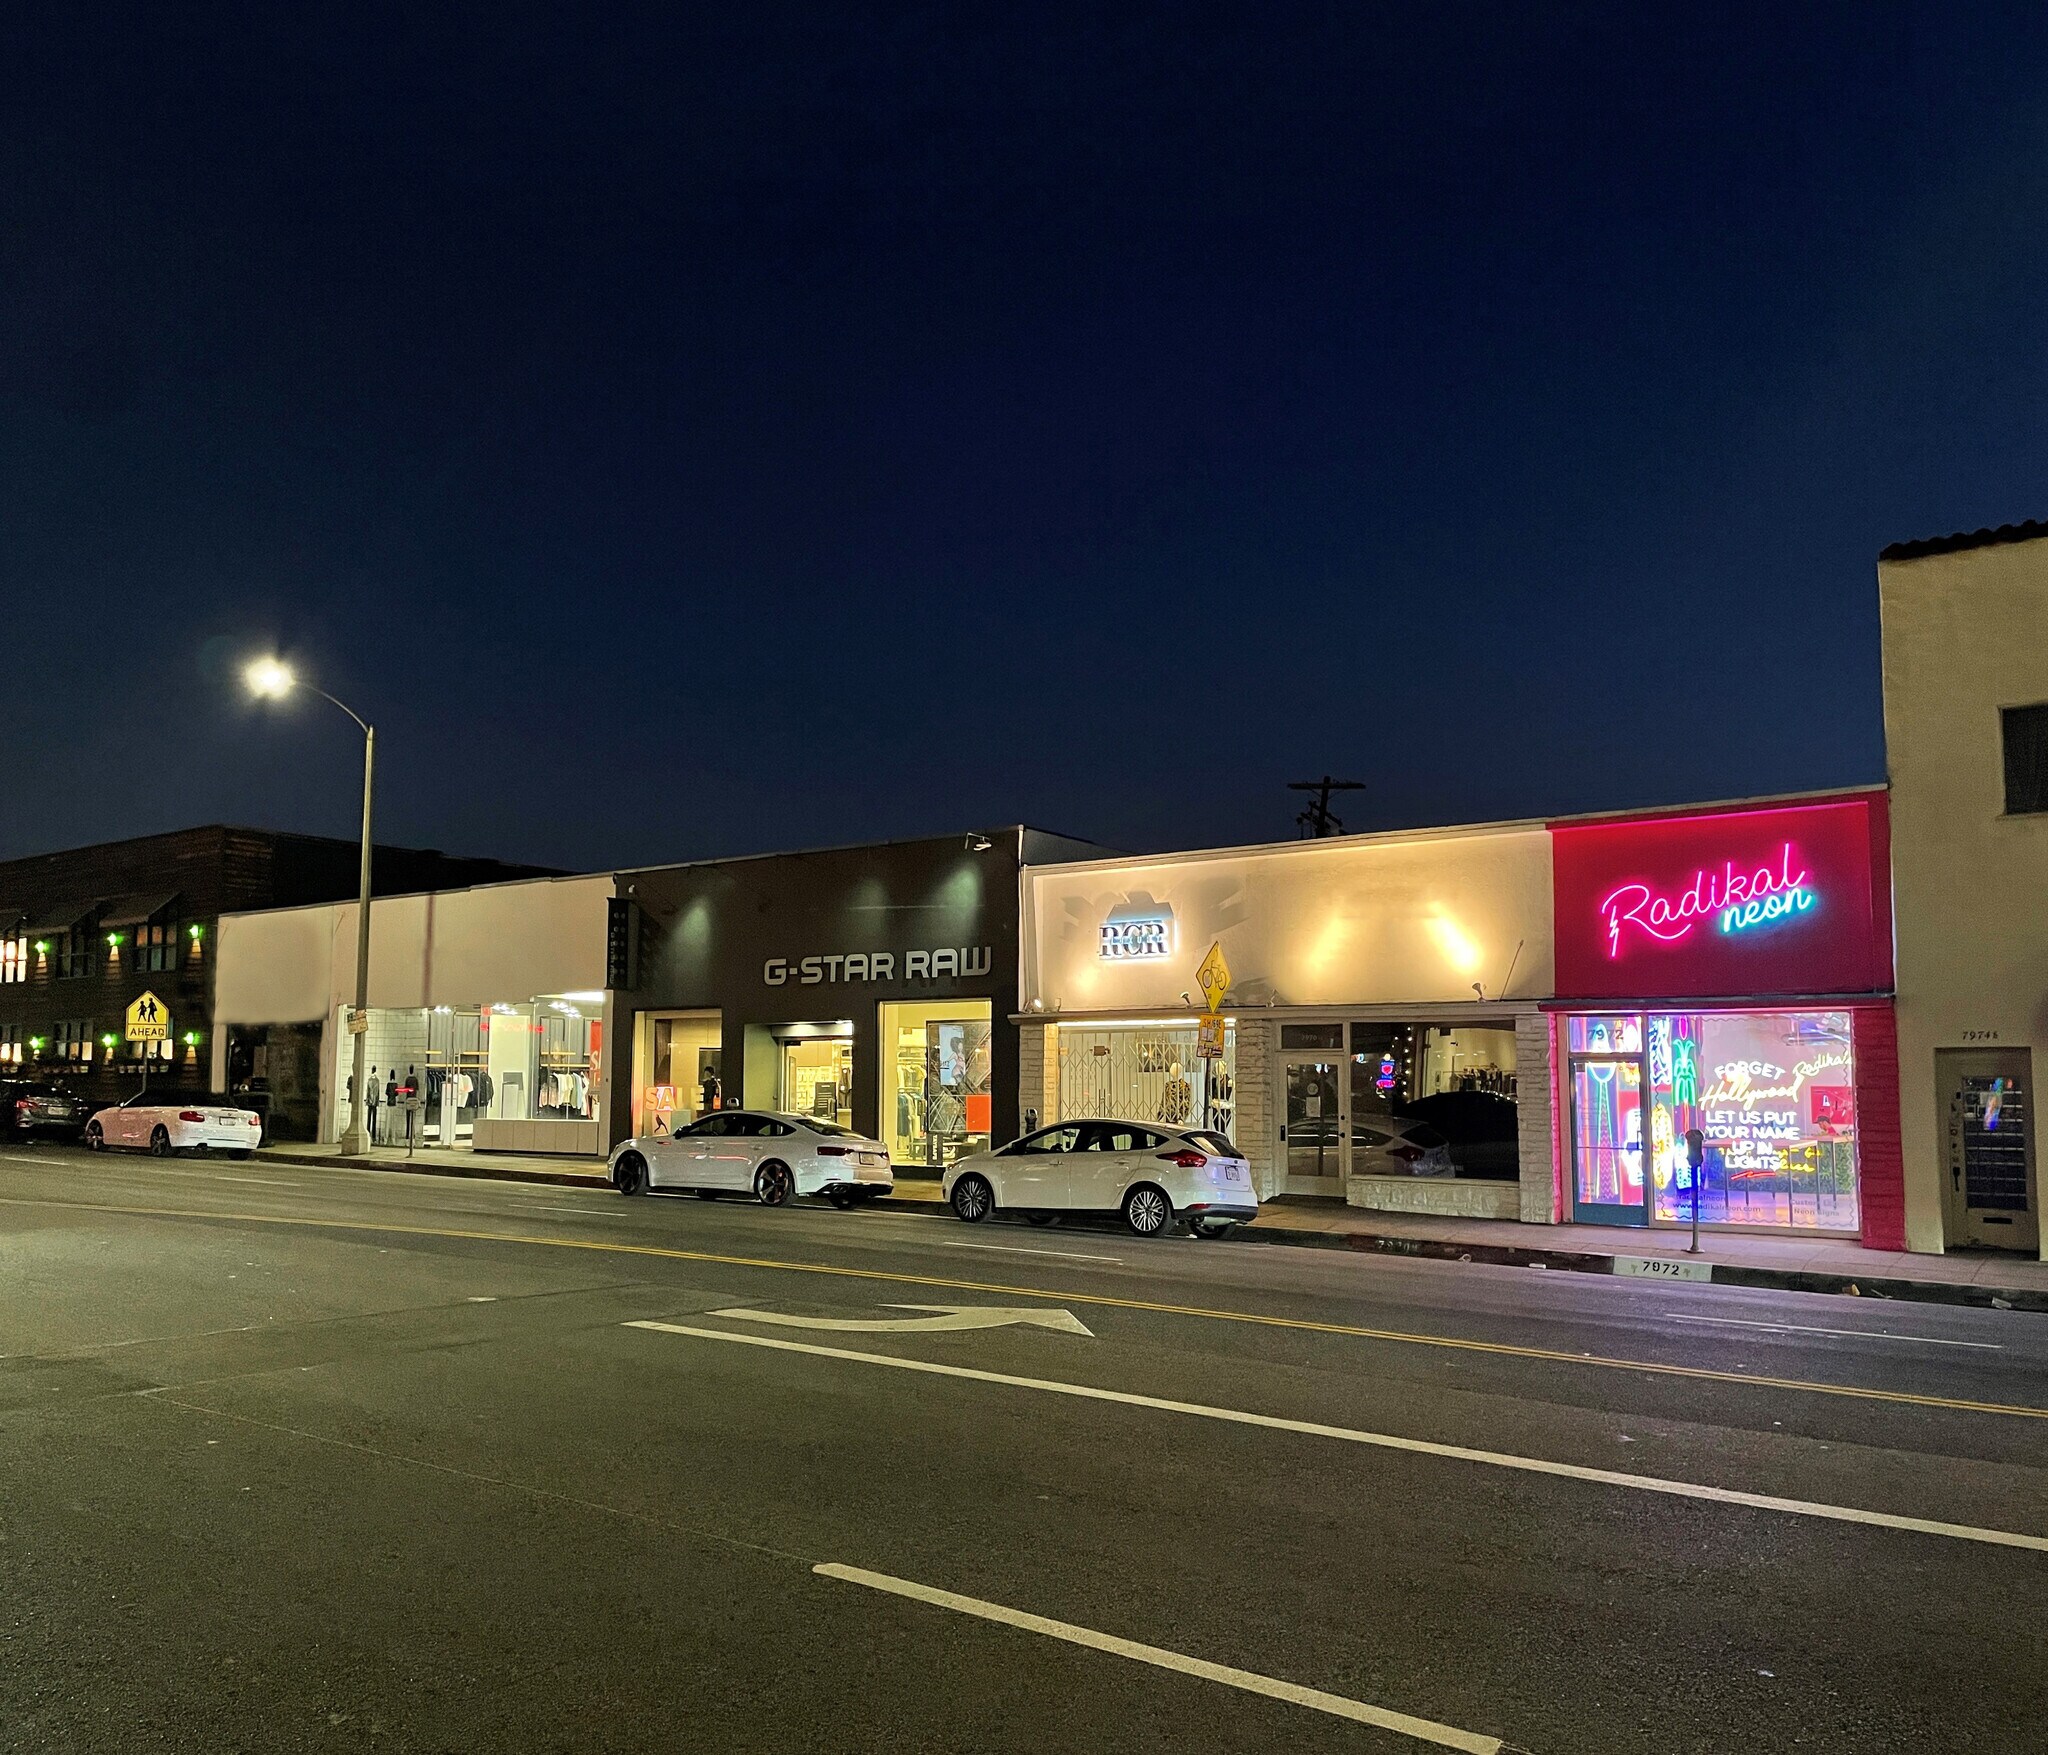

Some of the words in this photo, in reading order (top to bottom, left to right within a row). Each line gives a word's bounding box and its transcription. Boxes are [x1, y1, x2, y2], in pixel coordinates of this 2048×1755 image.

[1602, 843, 1805, 957] Radikal
[1724, 888, 1811, 932] neon
[764, 953, 894, 986] G-STAR
[906, 947, 991, 979] RAW
[130, 1028, 165, 1037] AHEAD
[1714, 1061, 1786, 1080] FORGET
[645, 1085, 704, 1111] SALE
[1698, 1075, 1804, 1110] Hollywood
[1706, 1111, 1736, 1124] LET
[1739, 1111, 1761, 1124] US
[1764, 1111, 1797, 1125] PUT
[1705, 1125, 1750, 1139] YOUR
[1752, 1126, 1800, 1141] NAME
[1732, 1140, 1755, 1155] UP
[1757, 1141, 1773, 1155] IN
[1725, 1156, 1780, 1170] LIGHTS
[1643, 1261, 1680, 1276] 7972
